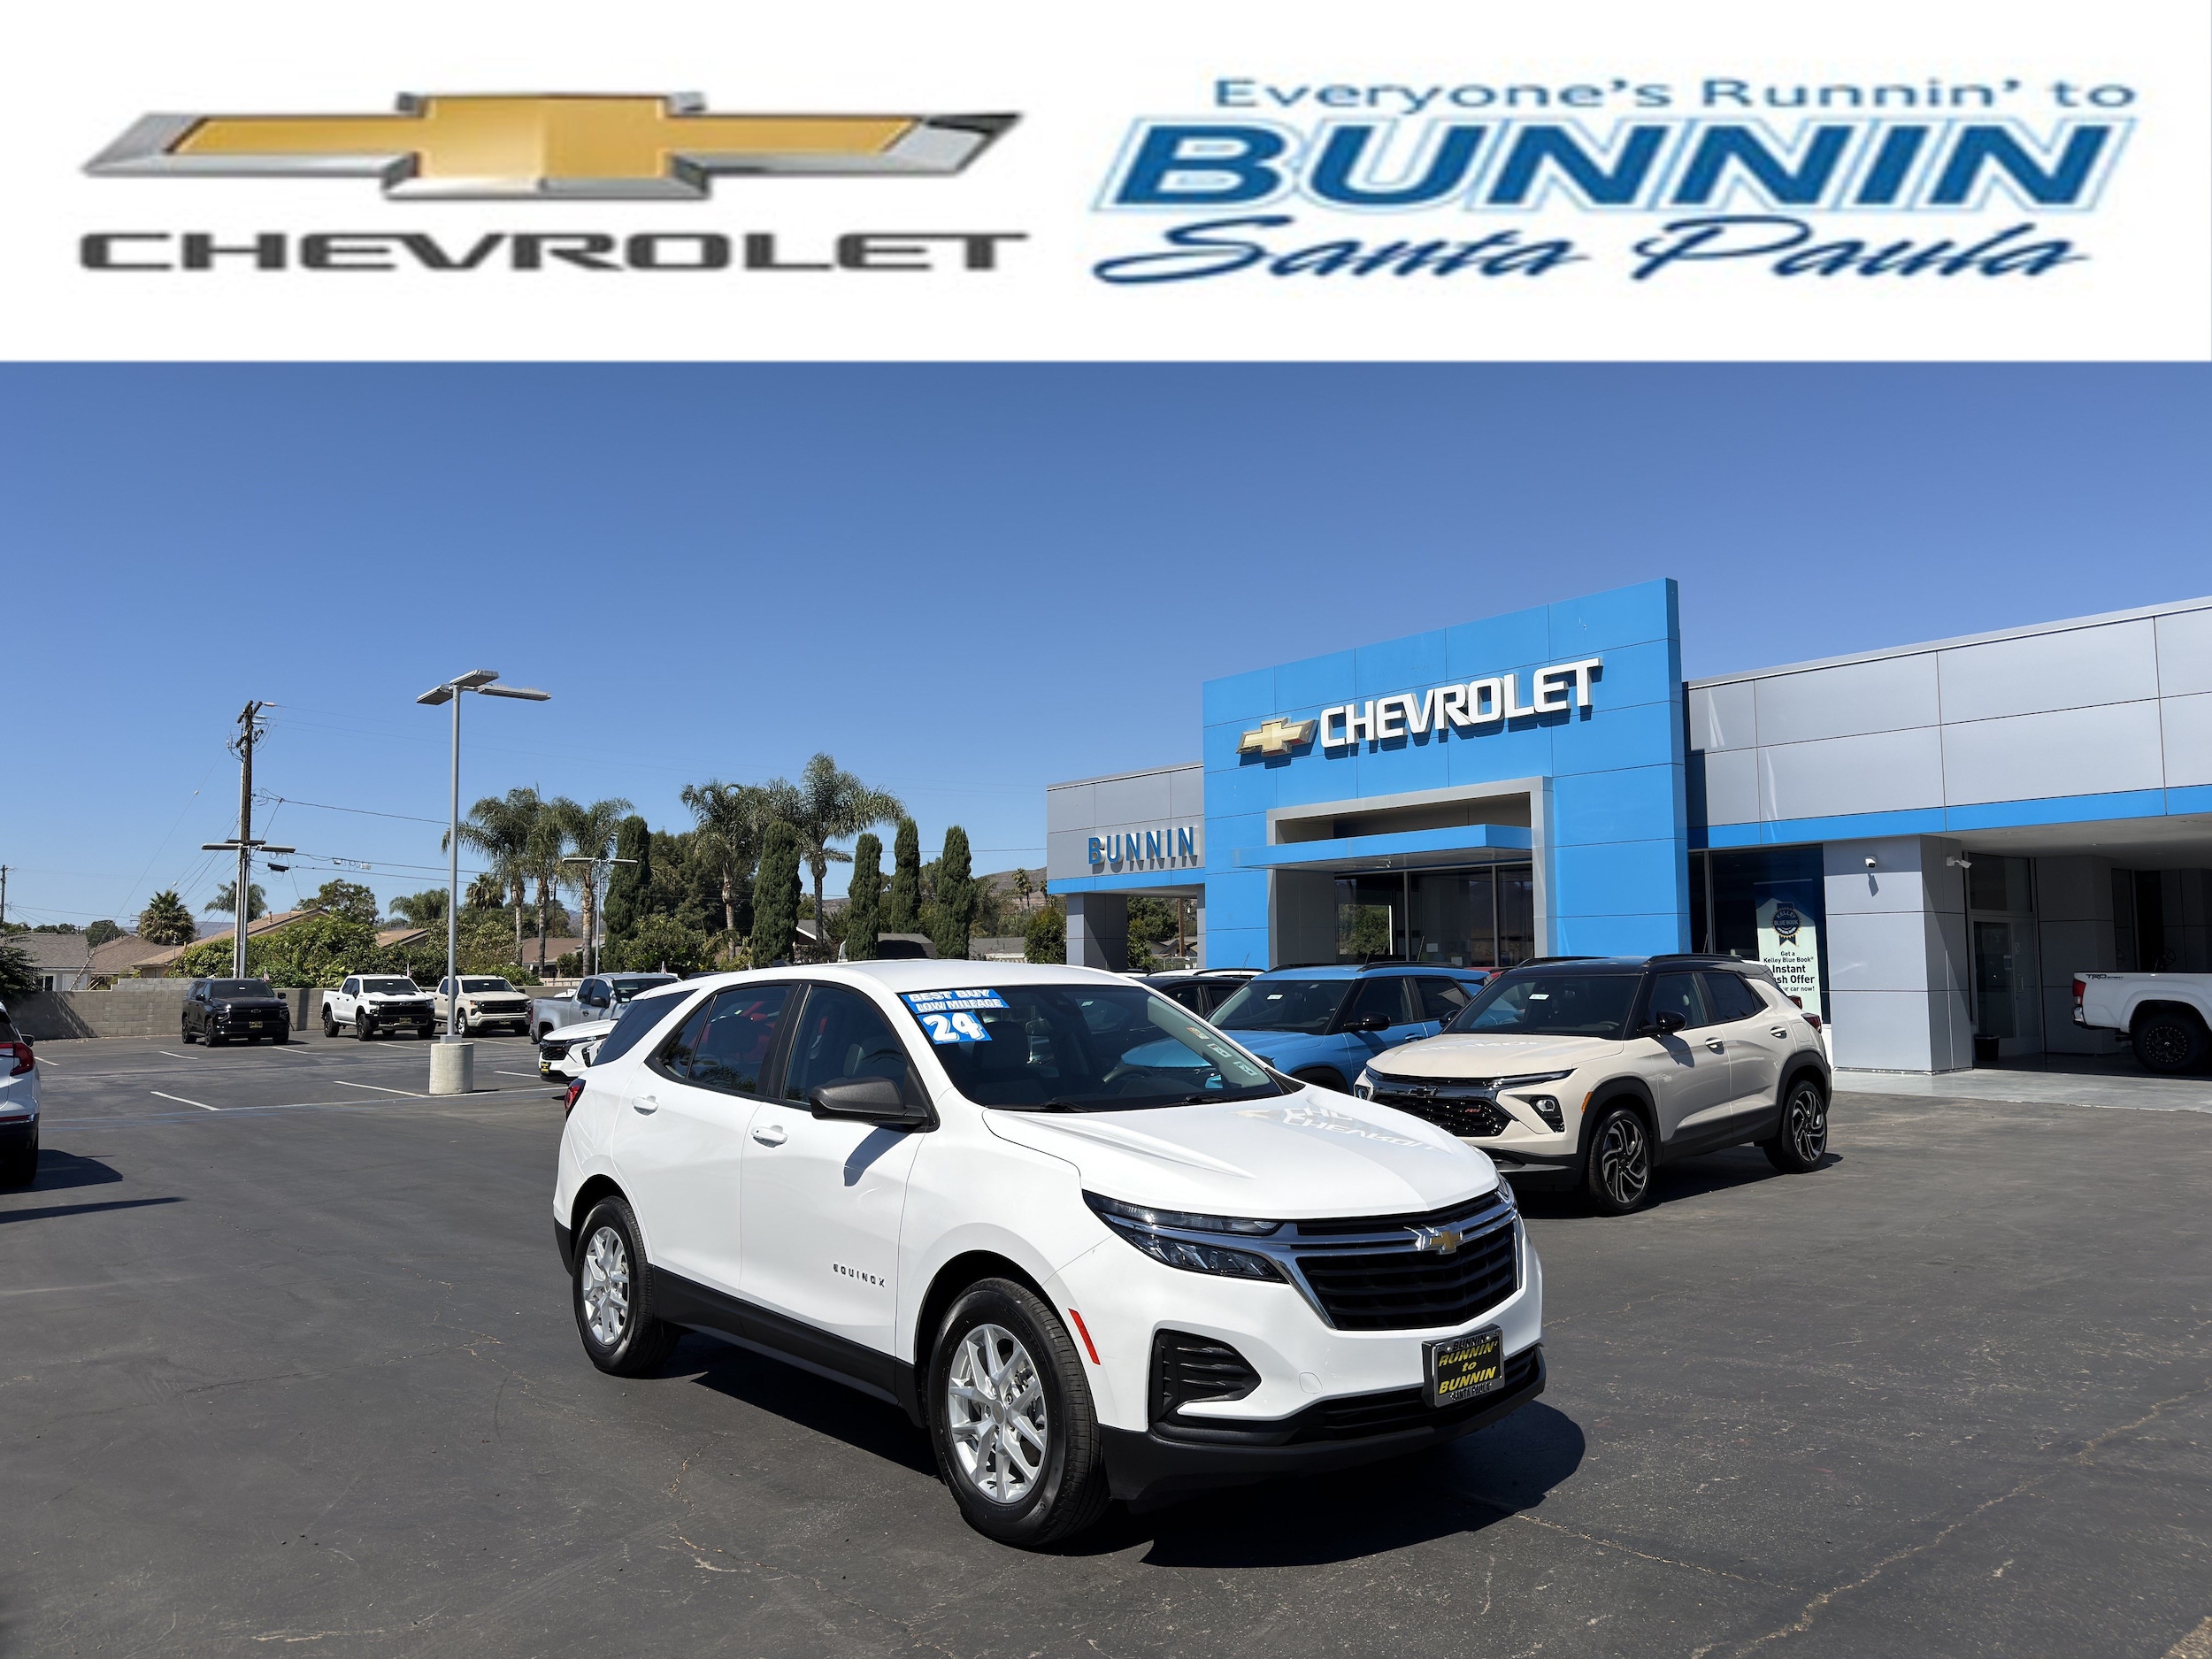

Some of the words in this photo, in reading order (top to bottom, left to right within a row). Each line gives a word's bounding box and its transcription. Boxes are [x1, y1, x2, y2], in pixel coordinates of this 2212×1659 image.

[1320, 657, 1603, 749] CHEVROLET
[1088, 826, 1199, 864] BUNNIN
[1772, 964, 1806, 973] Instant
[1790, 974, 1815, 984] Offer
[908, 992, 952, 1002] BEST
[956, 989, 991, 999] BUY
[915, 1001, 947, 1013] LOW
[947, 998, 1003, 1010] MILEAGE
[923, 1012, 986, 1041] 24
[833, 1263, 885, 1288] EQUINOX
[1462, 1361, 1477, 1372] to
[1439, 1365, 1496, 1394] BUNNIN
